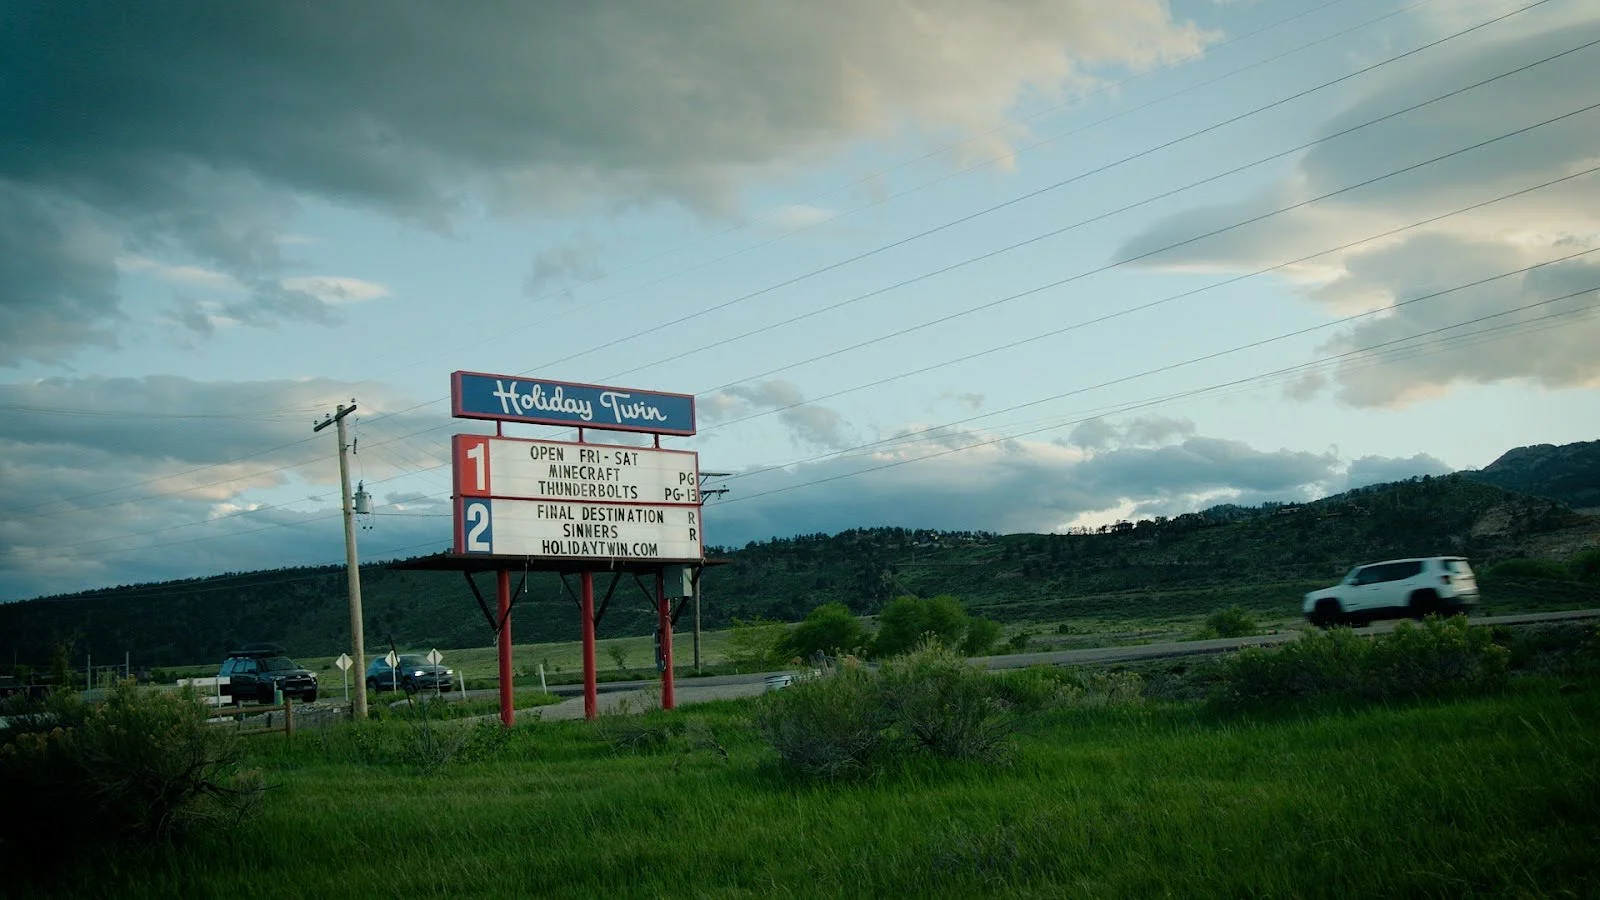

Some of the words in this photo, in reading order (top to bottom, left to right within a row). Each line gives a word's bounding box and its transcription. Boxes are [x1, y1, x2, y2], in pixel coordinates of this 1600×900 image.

[493, 380, 593, 421] Holiday
[600, 391, 667, 423] Twin
[530, 446, 564, 461] OPEN
[467, 443, 486, 491] 1
[549, 465, 620, 481] MINECRAFT
[679, 472, 695, 486] PG
[538, 481, 638, 499] THUNDERBOLTS
[665, 488, 697, 502] PG-13
[537, 505, 575, 520] FINAL
[582, 507, 664, 524] DESTINATION
[688, 511, 696, 525] R
[467, 503, 489, 552] 2
[563, 523, 618, 539] SINNERS
[689, 528, 697, 541] R
[542, 540, 658, 556] HOLIDAYTWIN.COM
